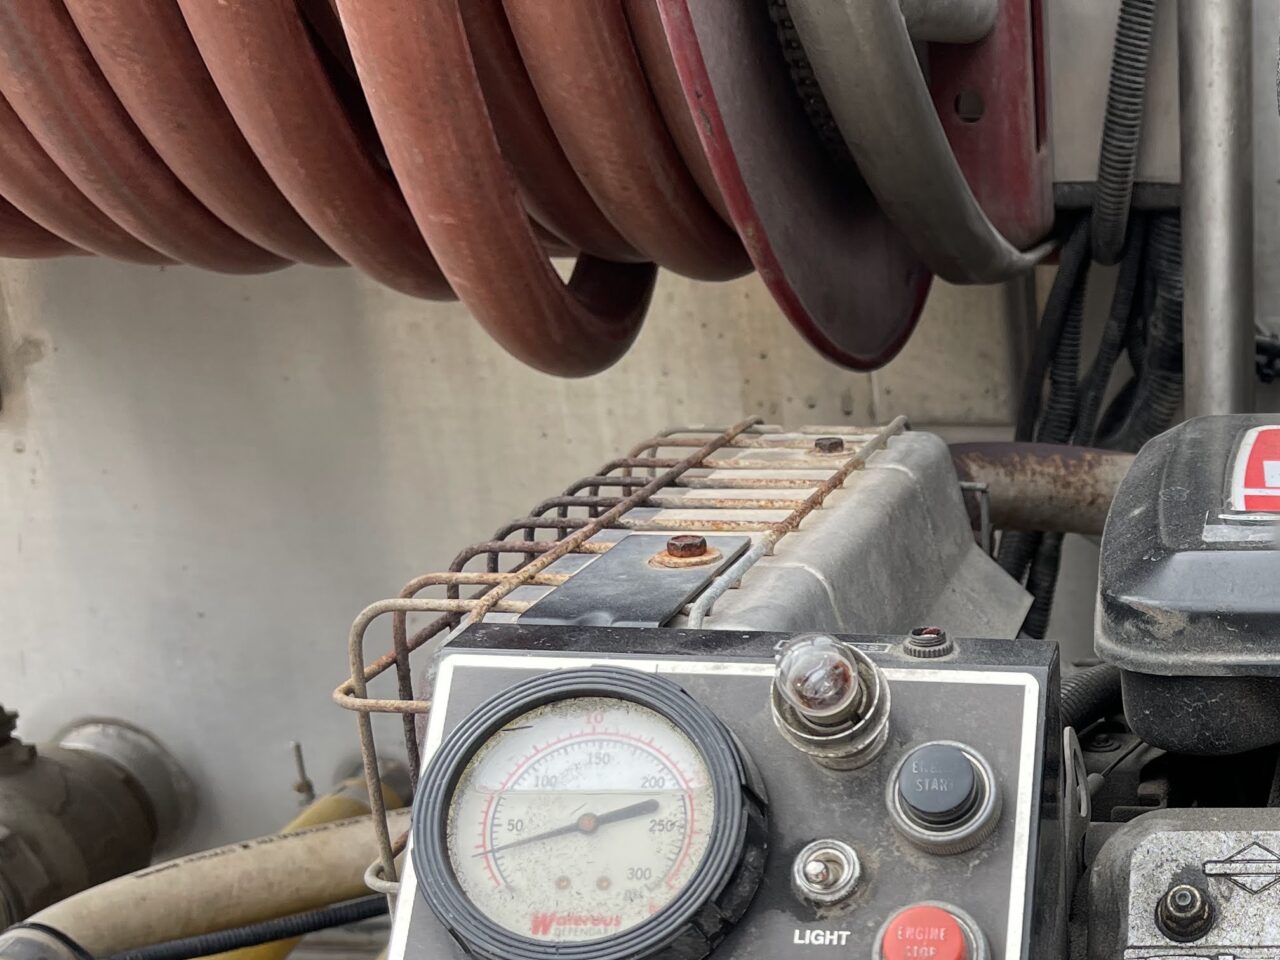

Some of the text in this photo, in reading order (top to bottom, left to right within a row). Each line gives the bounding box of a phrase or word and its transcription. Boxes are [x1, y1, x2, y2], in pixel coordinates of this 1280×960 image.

[587, 752, 610, 764] 150
[534, 775, 557, 787] 100
[641, 776, 665, 788] 200
[507, 819, 524, 832] 50
[649, 819, 676, 832] 250
[627, 867, 651, 880] 300
[793, 929, 851, 945] LIGHT
